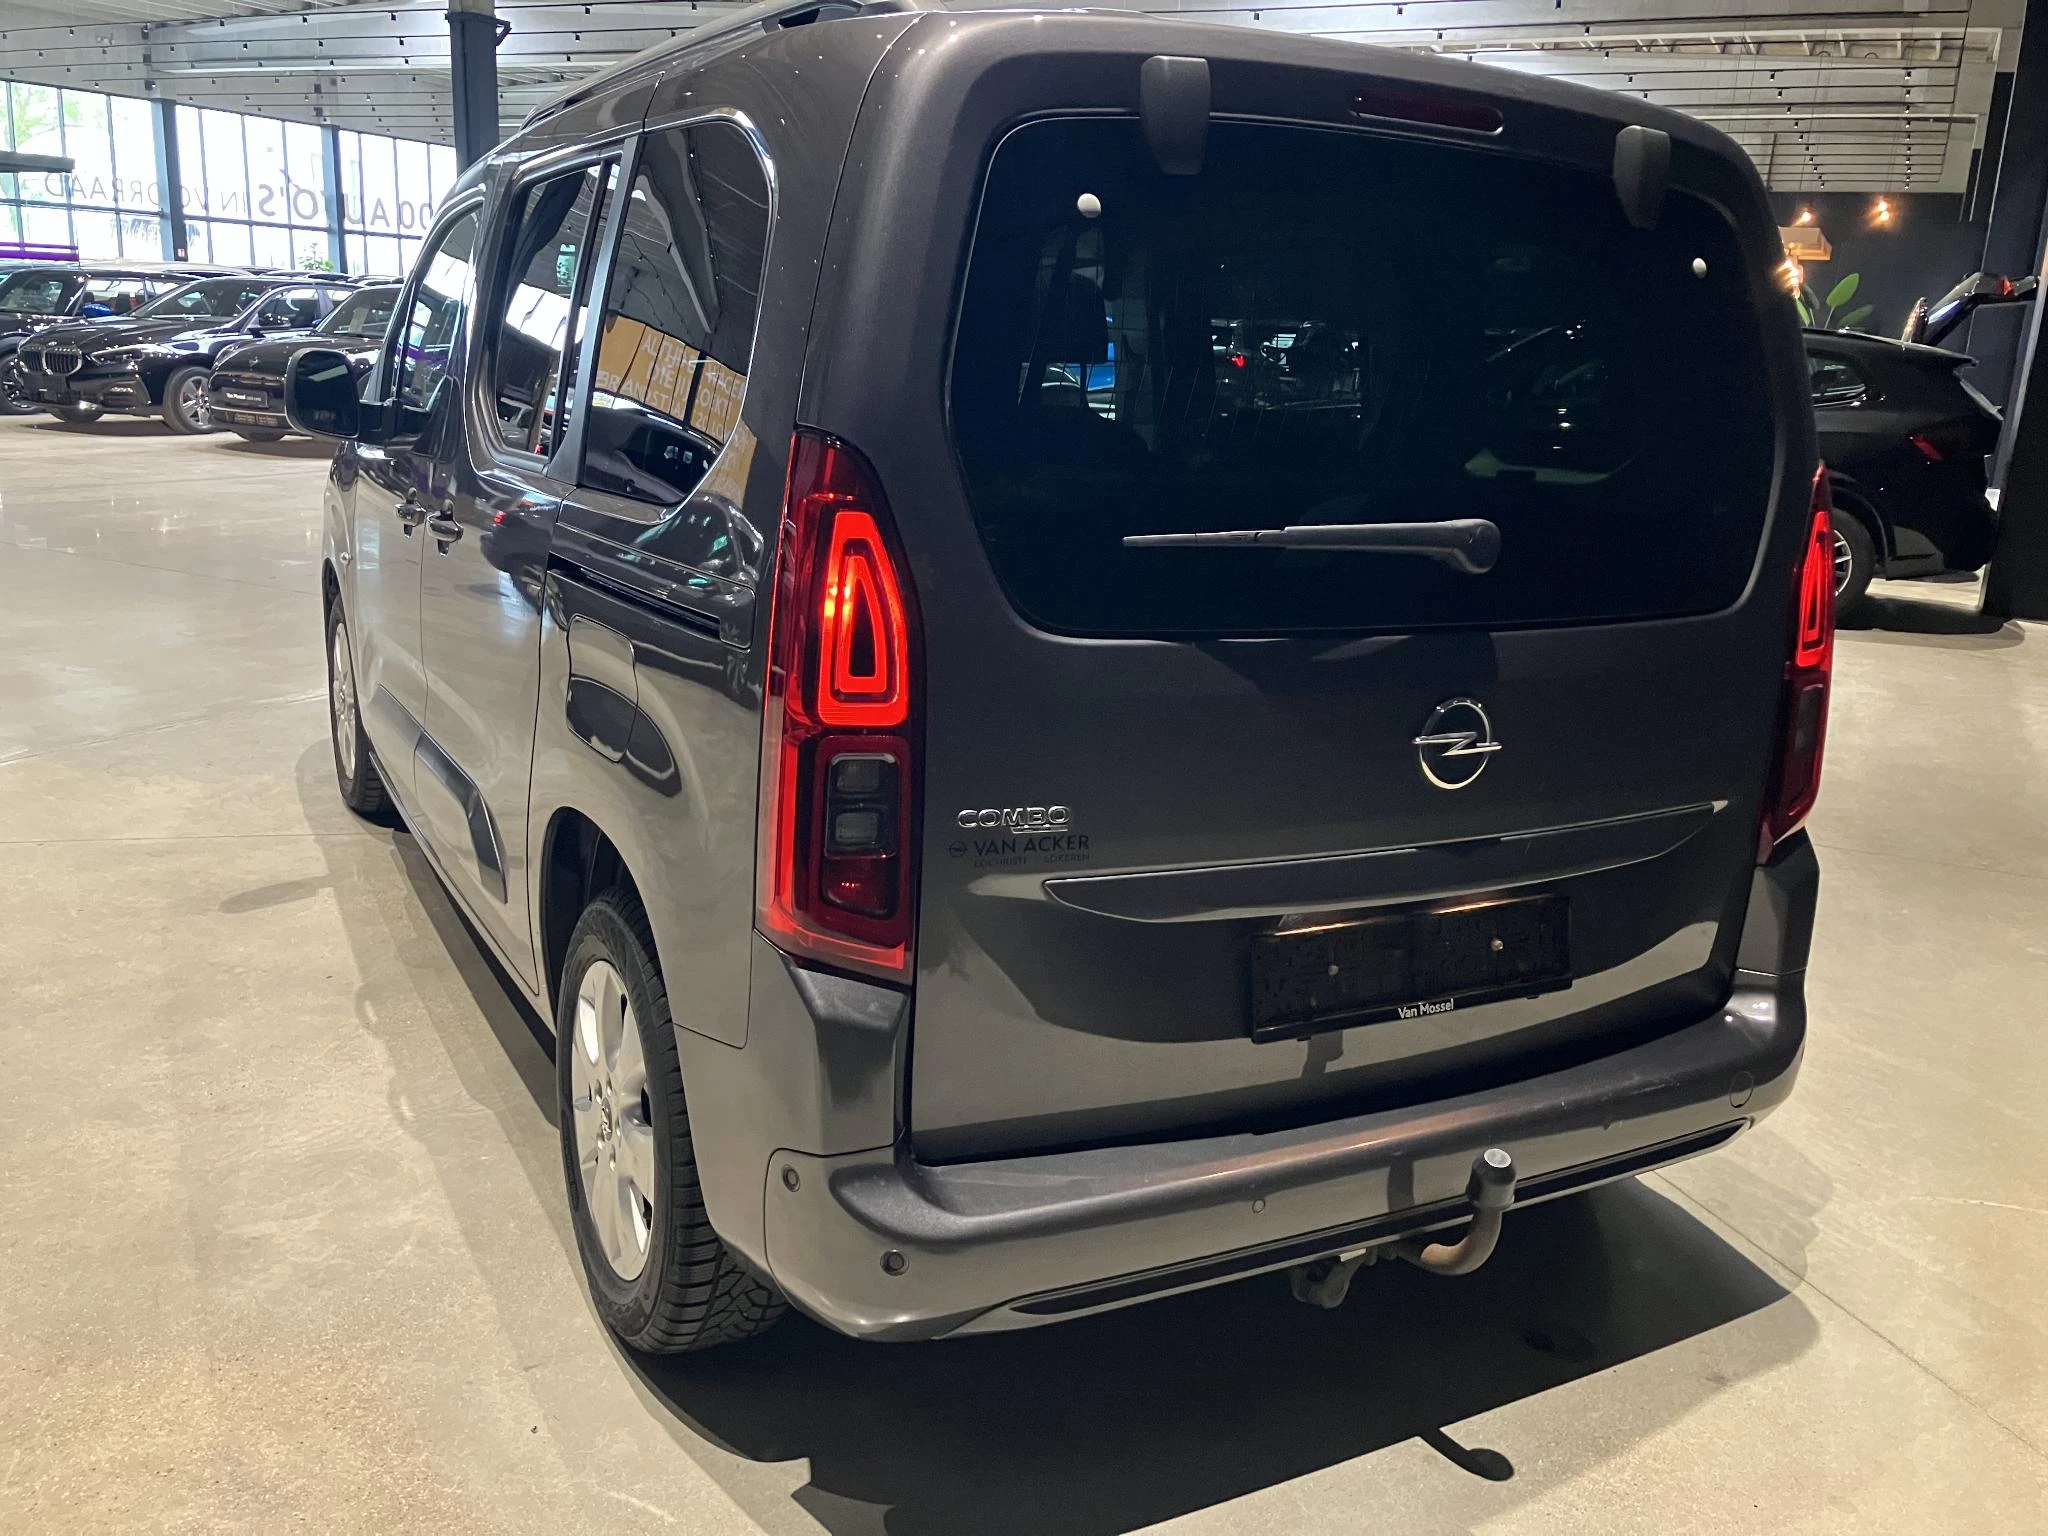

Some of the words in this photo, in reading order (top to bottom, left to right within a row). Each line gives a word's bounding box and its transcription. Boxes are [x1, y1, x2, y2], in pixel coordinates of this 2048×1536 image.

[957, 805, 1070, 828] COMBO
[974, 839, 1015, 855] VAN
[1023, 834, 1090, 853] ACKER
[1398, 1007, 1417, 1018] Van
[1420, 998, 1454, 1014] Mossel
